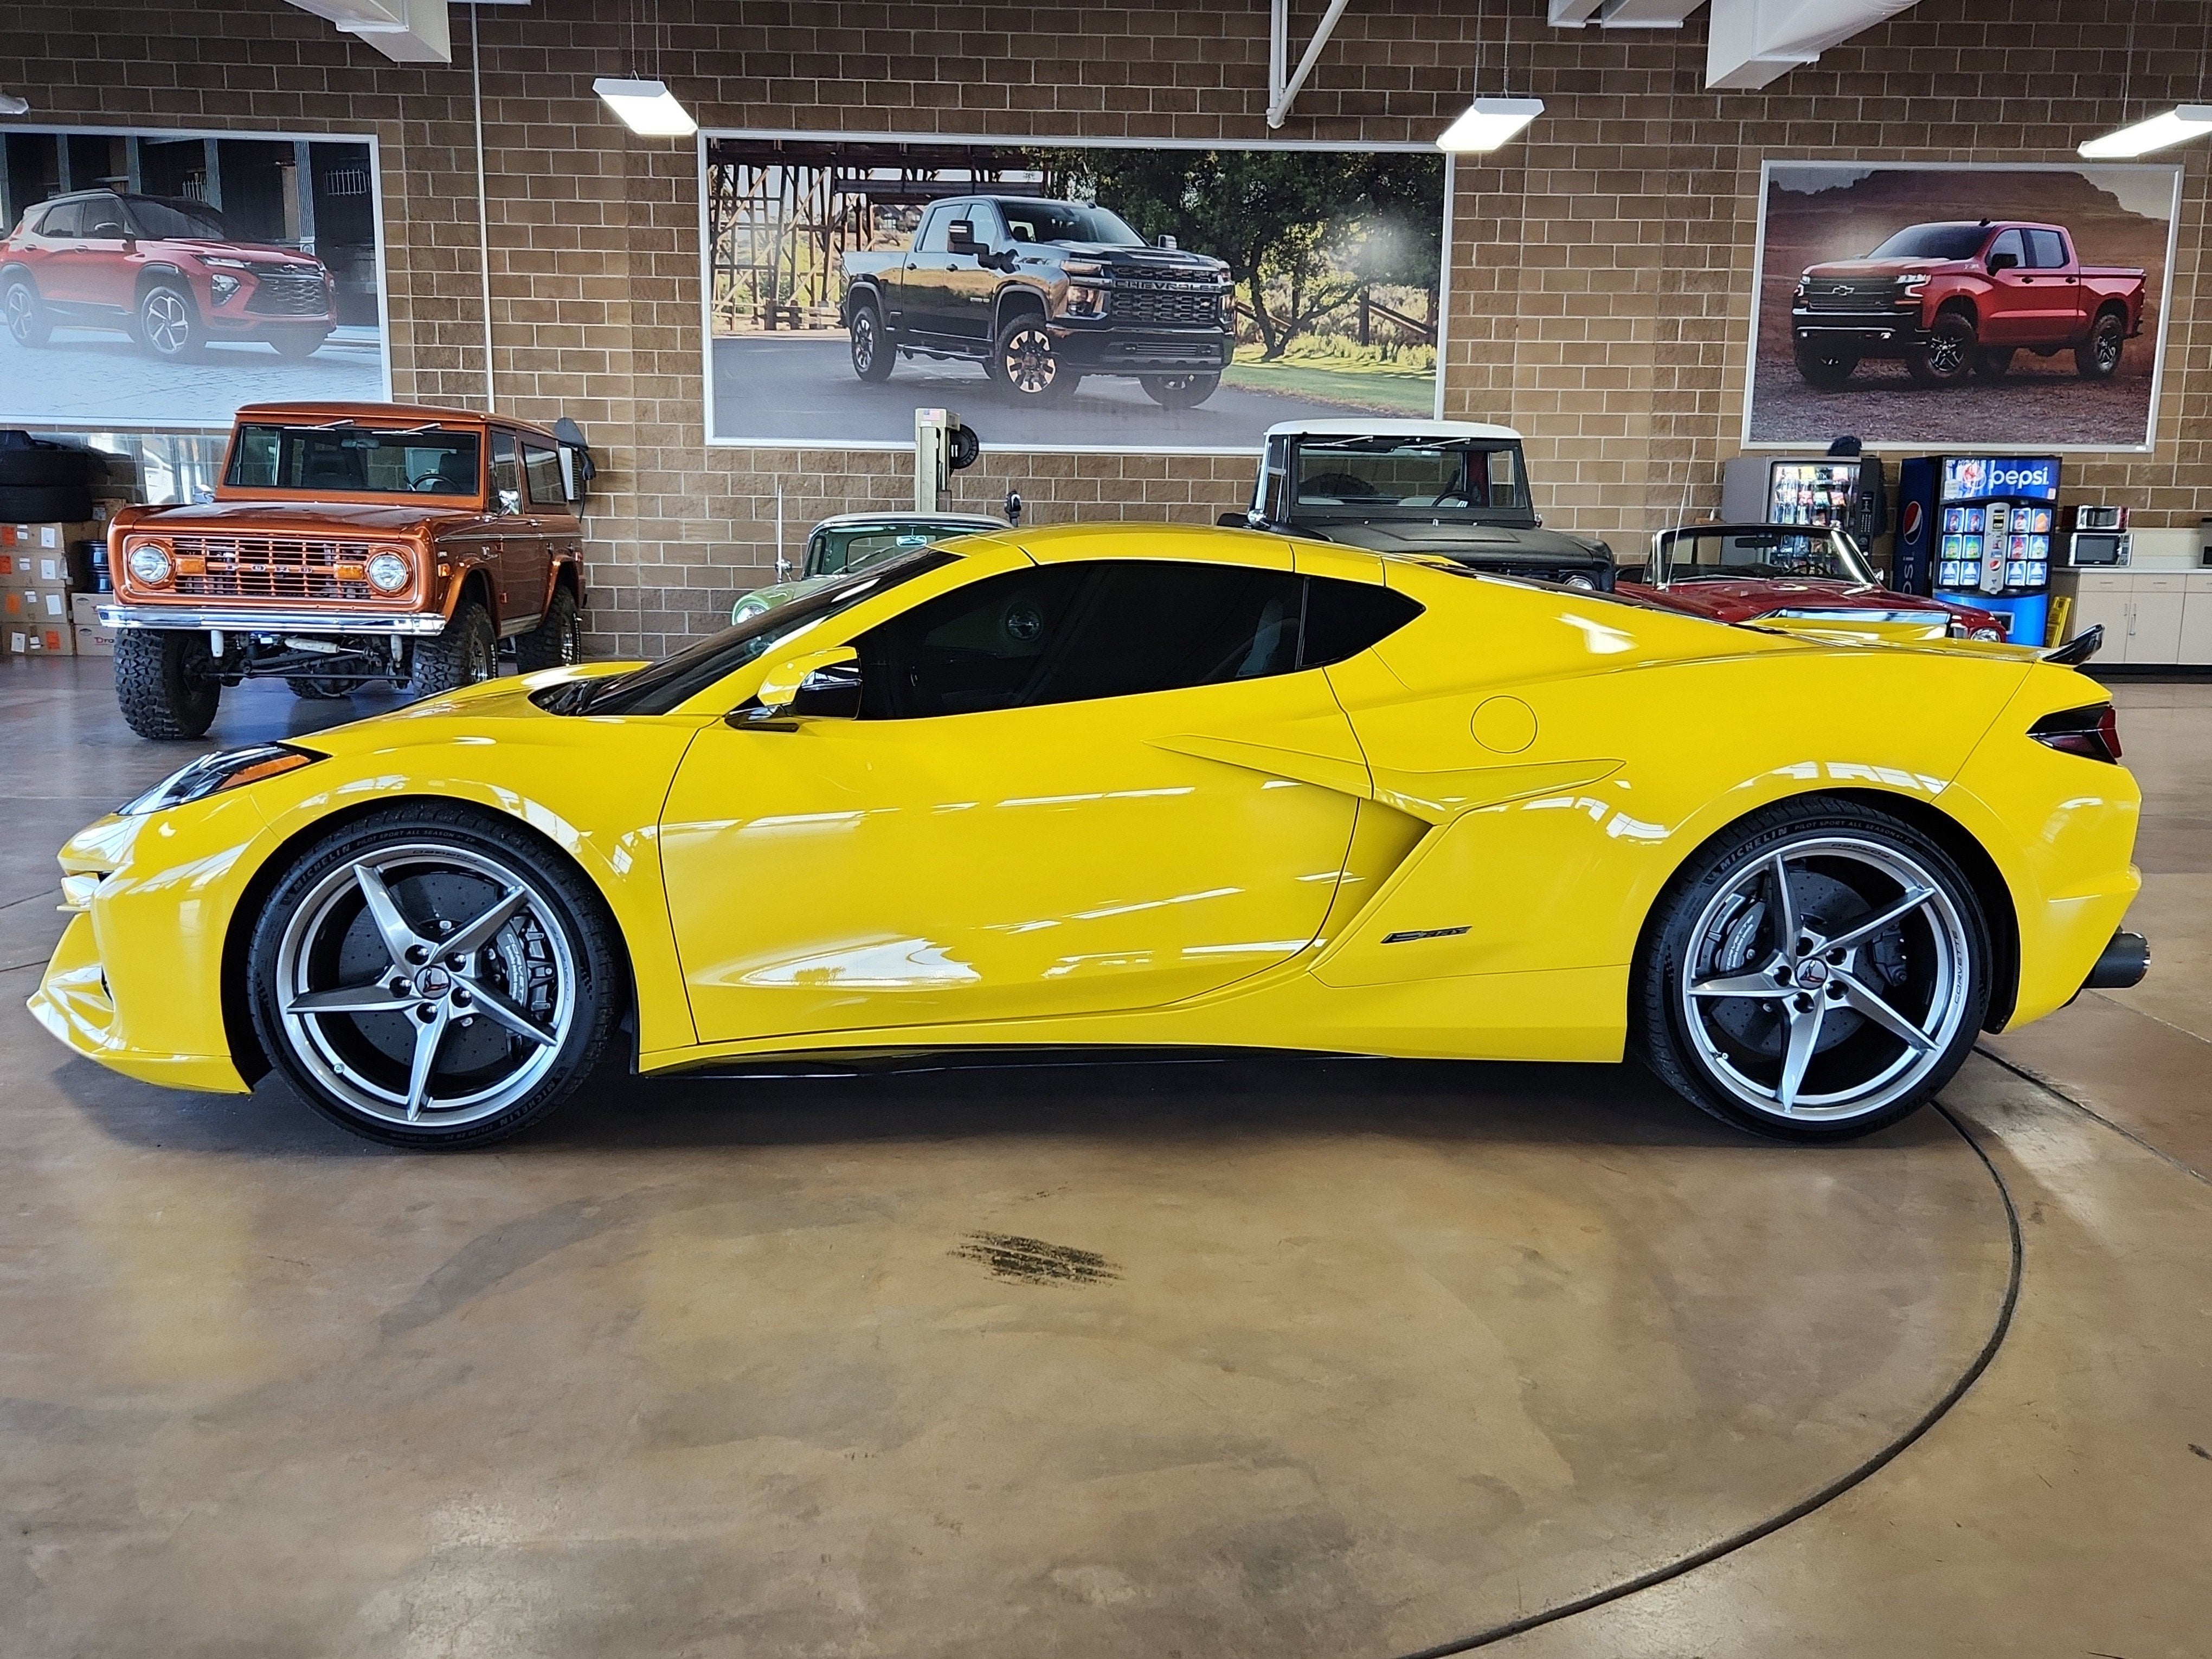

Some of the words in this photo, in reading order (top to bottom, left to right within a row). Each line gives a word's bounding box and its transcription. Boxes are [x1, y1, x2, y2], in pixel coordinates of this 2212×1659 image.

[1115, 280, 1220, 292] CHEVROLET
[1990, 466, 2048, 489] pepsi
[293, 844, 350, 891] MICHELIN
[356, 836, 377, 846] PILOT
[380, 830, 404, 839] SPORT
[1720, 827, 1787, 870] MICHELIN
[1795, 821, 1816, 830] PILOT
[1866, 823, 1895, 837] SEASON
[507, 933, 524, 1007] CORVETT
[1952, 930, 1963, 1004] CORVETTE
[500, 1081, 556, 1126] MICHELIN
